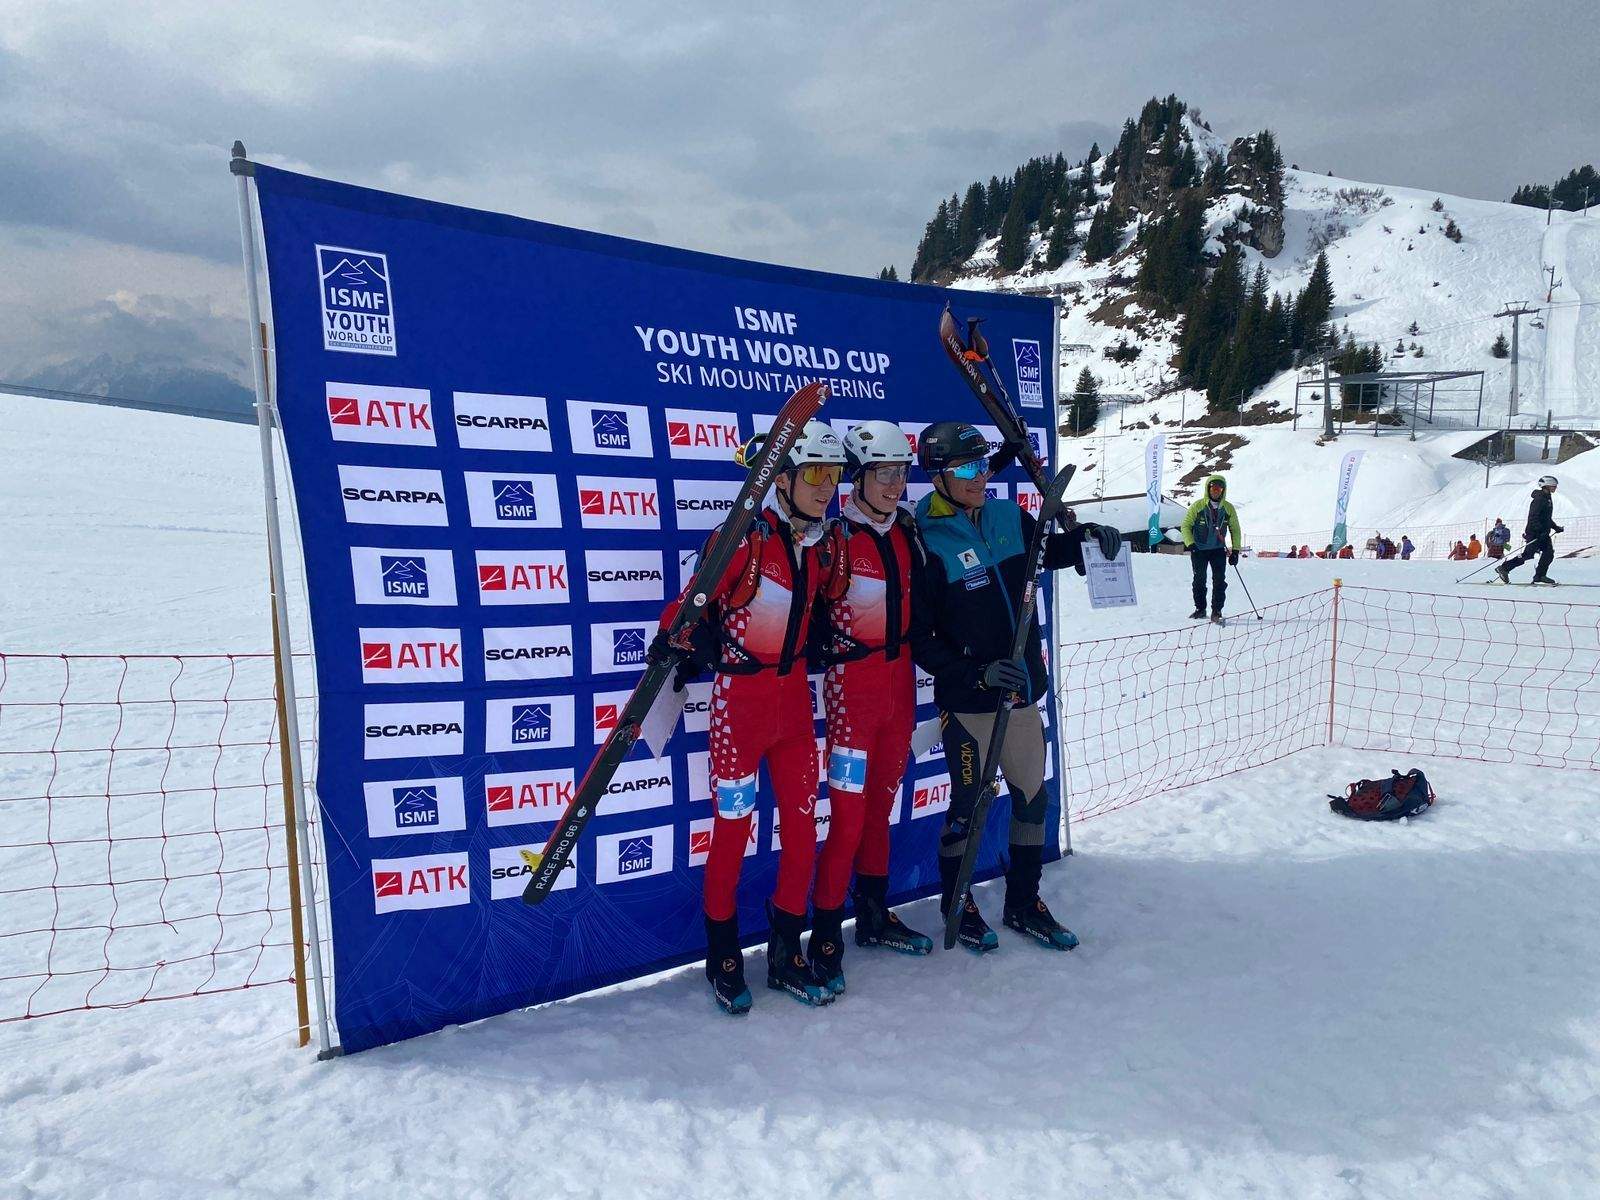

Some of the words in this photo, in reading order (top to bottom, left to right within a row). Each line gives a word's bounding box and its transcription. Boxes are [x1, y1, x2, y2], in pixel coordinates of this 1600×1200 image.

[330, 287, 385, 310] ISMF
[326, 311, 390, 334] YOUTH
[734, 306, 798, 336] ISMF
[327, 330, 368, 343] WORLD
[371, 334, 393, 345] CUP
[634, 325, 740, 361] YOUTH
[744, 338, 840, 371] WORLD
[846, 350, 891, 375] CUP
[656, 361, 692, 386] SKI
[699, 366, 886, 401] MOUNTAIERING
[1020, 366, 1039, 379] ISMF
[1020, 382, 1041, 395] YOUTH
[366, 400, 432, 430] ATK
[456, 414, 548, 431] SCARPA
[596, 432, 628, 446] ISMF
[694, 424, 740, 448] ATK
[1343, 463, 1354, 490] VILLARS
[343, 487, 444, 505] SCARPA
[608, 491, 659, 516] ATK
[676, 499, 735, 511] SCARP
[499, 505, 534, 518] ISMF
[510, 564, 567, 591] ATK
[587, 570, 664, 582] SCARPA
[747, 558, 757, 586] CAMP
[387, 580, 426, 595] ISMF
[834, 634, 857, 648] CAMP
[397, 642, 461, 669] ATK
[485, 645, 572, 661] SCARPA
[616, 650, 644, 663] ISMF
[726, 642, 749, 661] CAMP
[365, 722, 463, 738] SCARPA
[515, 727, 549, 741] ISMF
[843, 762, 852, 777] 1
[518, 781, 575, 808] ATK
[733, 792, 744, 806] 2
[929, 783, 950, 805] AT
[399, 810, 436, 824] ISMF
[535, 862, 554, 890] RACE
[552, 839, 570, 861] PRO
[566, 824, 579, 839] 66
[621, 857, 651, 872] ISMF
[491, 858, 576, 880] SCAA
[407, 864, 467, 895] ATK
